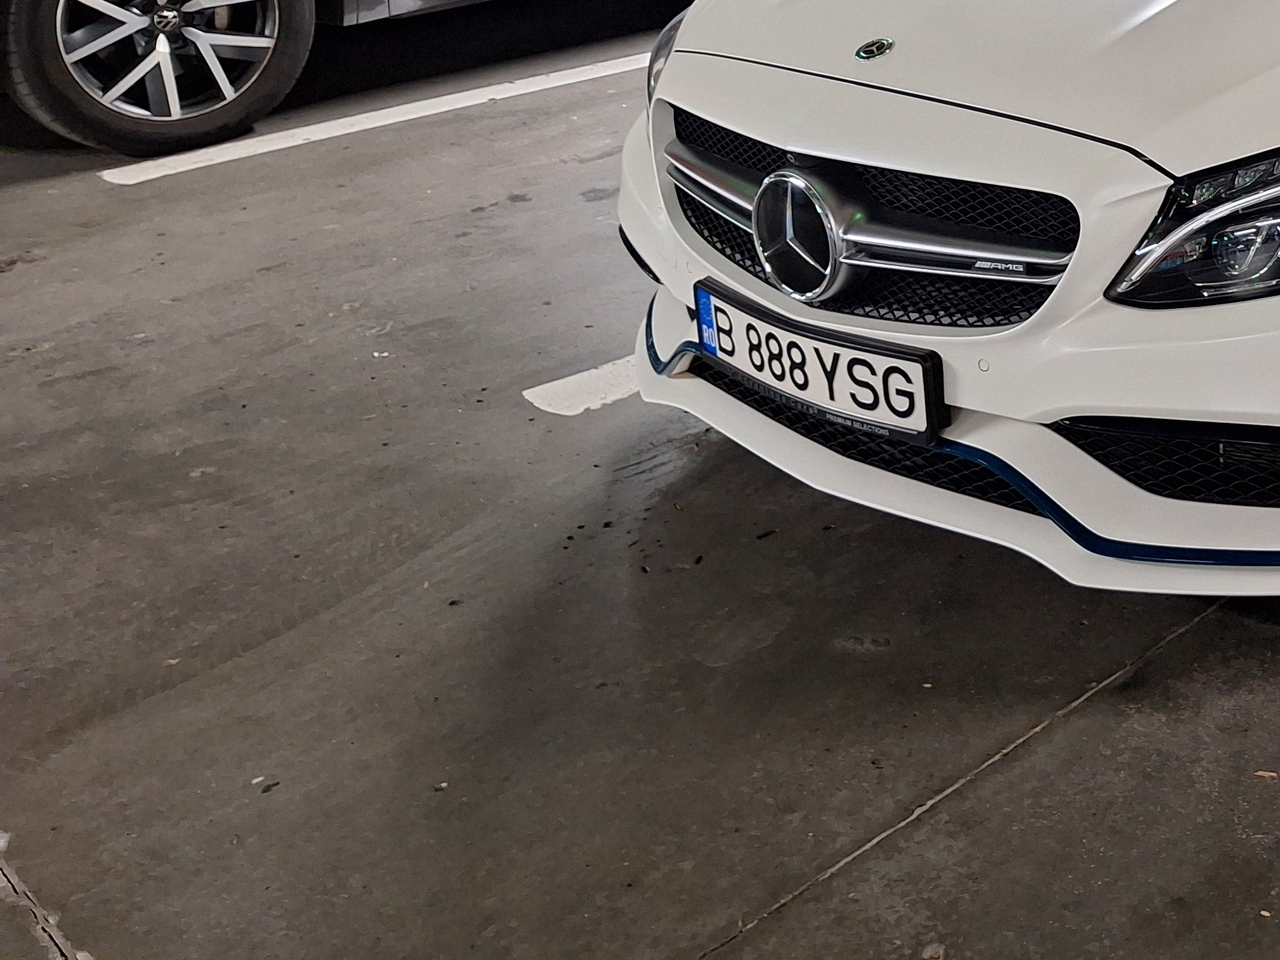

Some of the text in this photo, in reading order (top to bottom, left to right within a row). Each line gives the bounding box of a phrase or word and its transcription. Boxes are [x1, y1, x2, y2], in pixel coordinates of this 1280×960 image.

[989, 262, 1024, 271] AMG
[702, 324, 716, 347] RO
[714, 304, 735, 357] B
